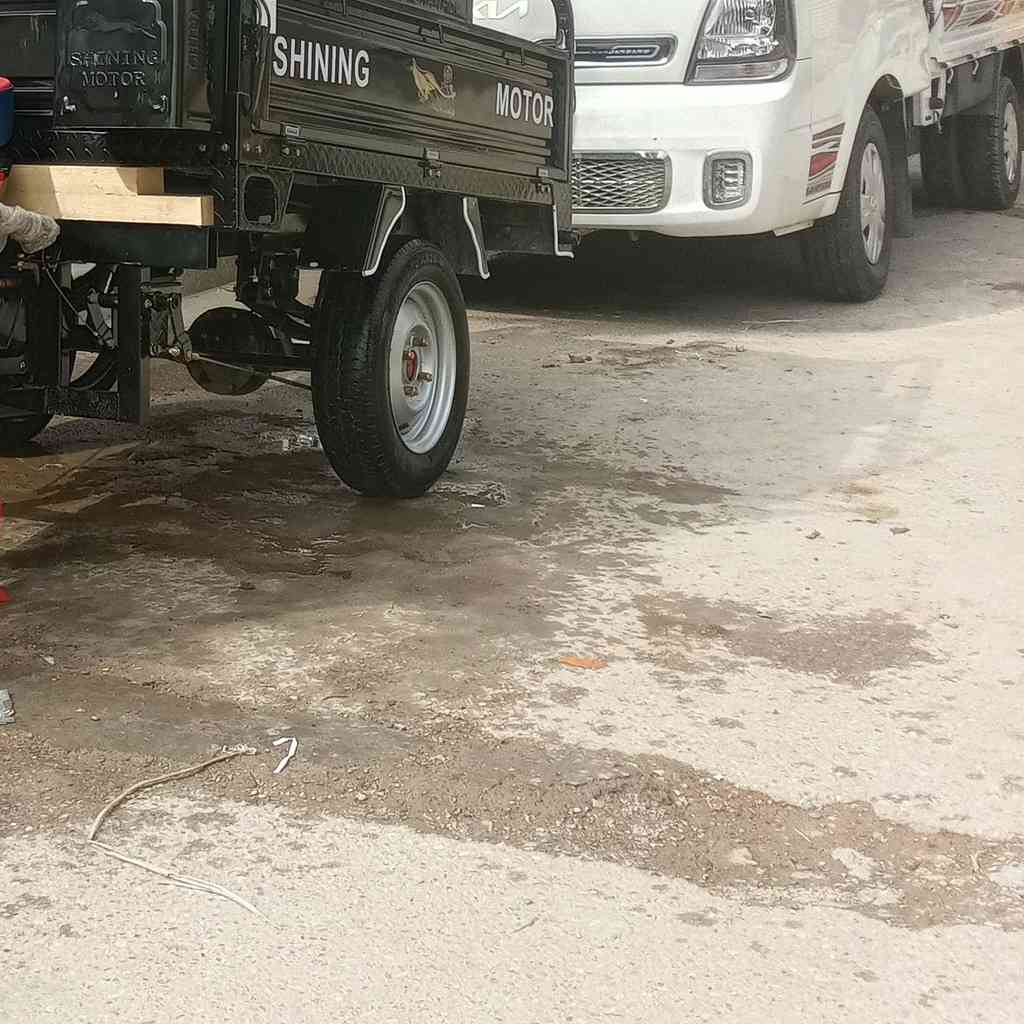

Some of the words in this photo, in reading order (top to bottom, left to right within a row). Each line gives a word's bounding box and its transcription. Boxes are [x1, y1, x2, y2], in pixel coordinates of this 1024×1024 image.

[70, 49, 160, 67] SHINING
[81, 71, 146, 87] MOTOR
[272, 36, 370, 88] SHINING
[495, 81, 554, 128] MOTOR
